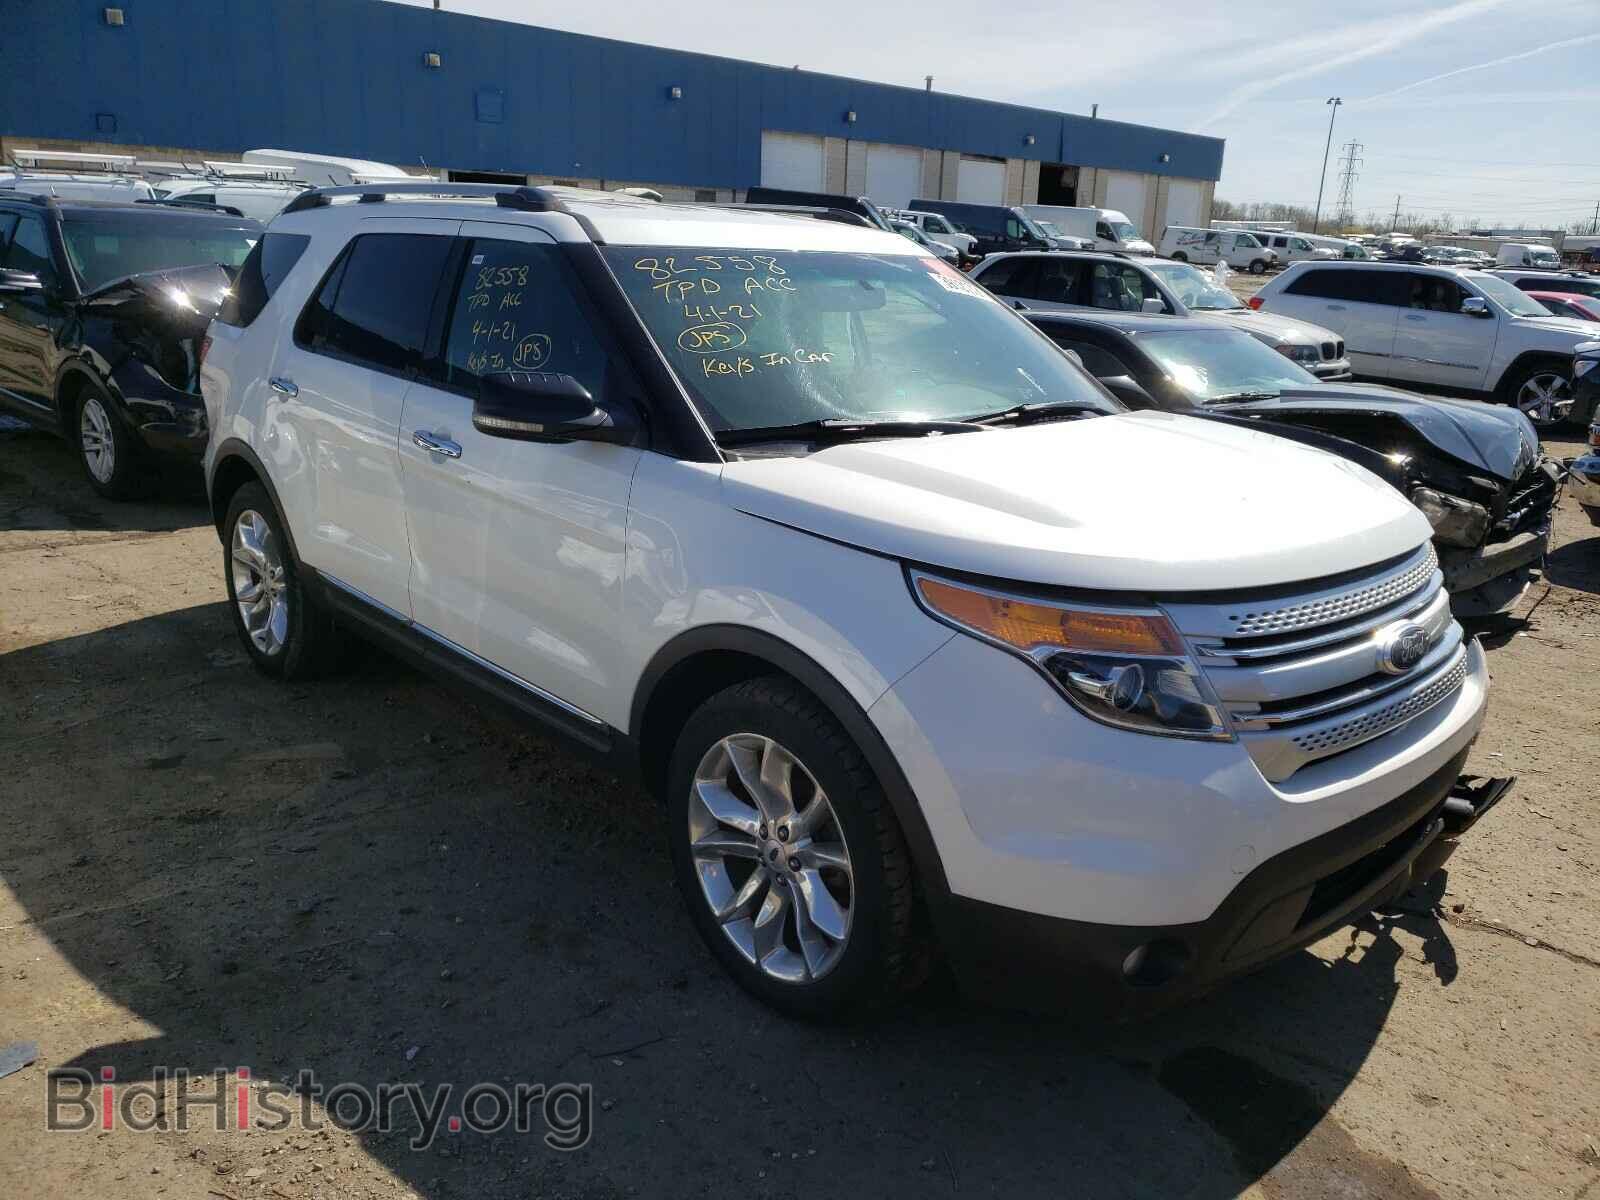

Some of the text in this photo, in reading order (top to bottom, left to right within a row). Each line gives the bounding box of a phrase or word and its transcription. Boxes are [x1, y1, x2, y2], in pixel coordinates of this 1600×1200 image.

[475, 265, 529, 290] 82558
[635, 256, 786, 280] 82558
[653, 277, 797, 304] TPD ACC
[472, 319, 515, 345] 4-1-21
[688, 328, 731, 348] JPS
[702, 348, 835, 379] Keys In Car
